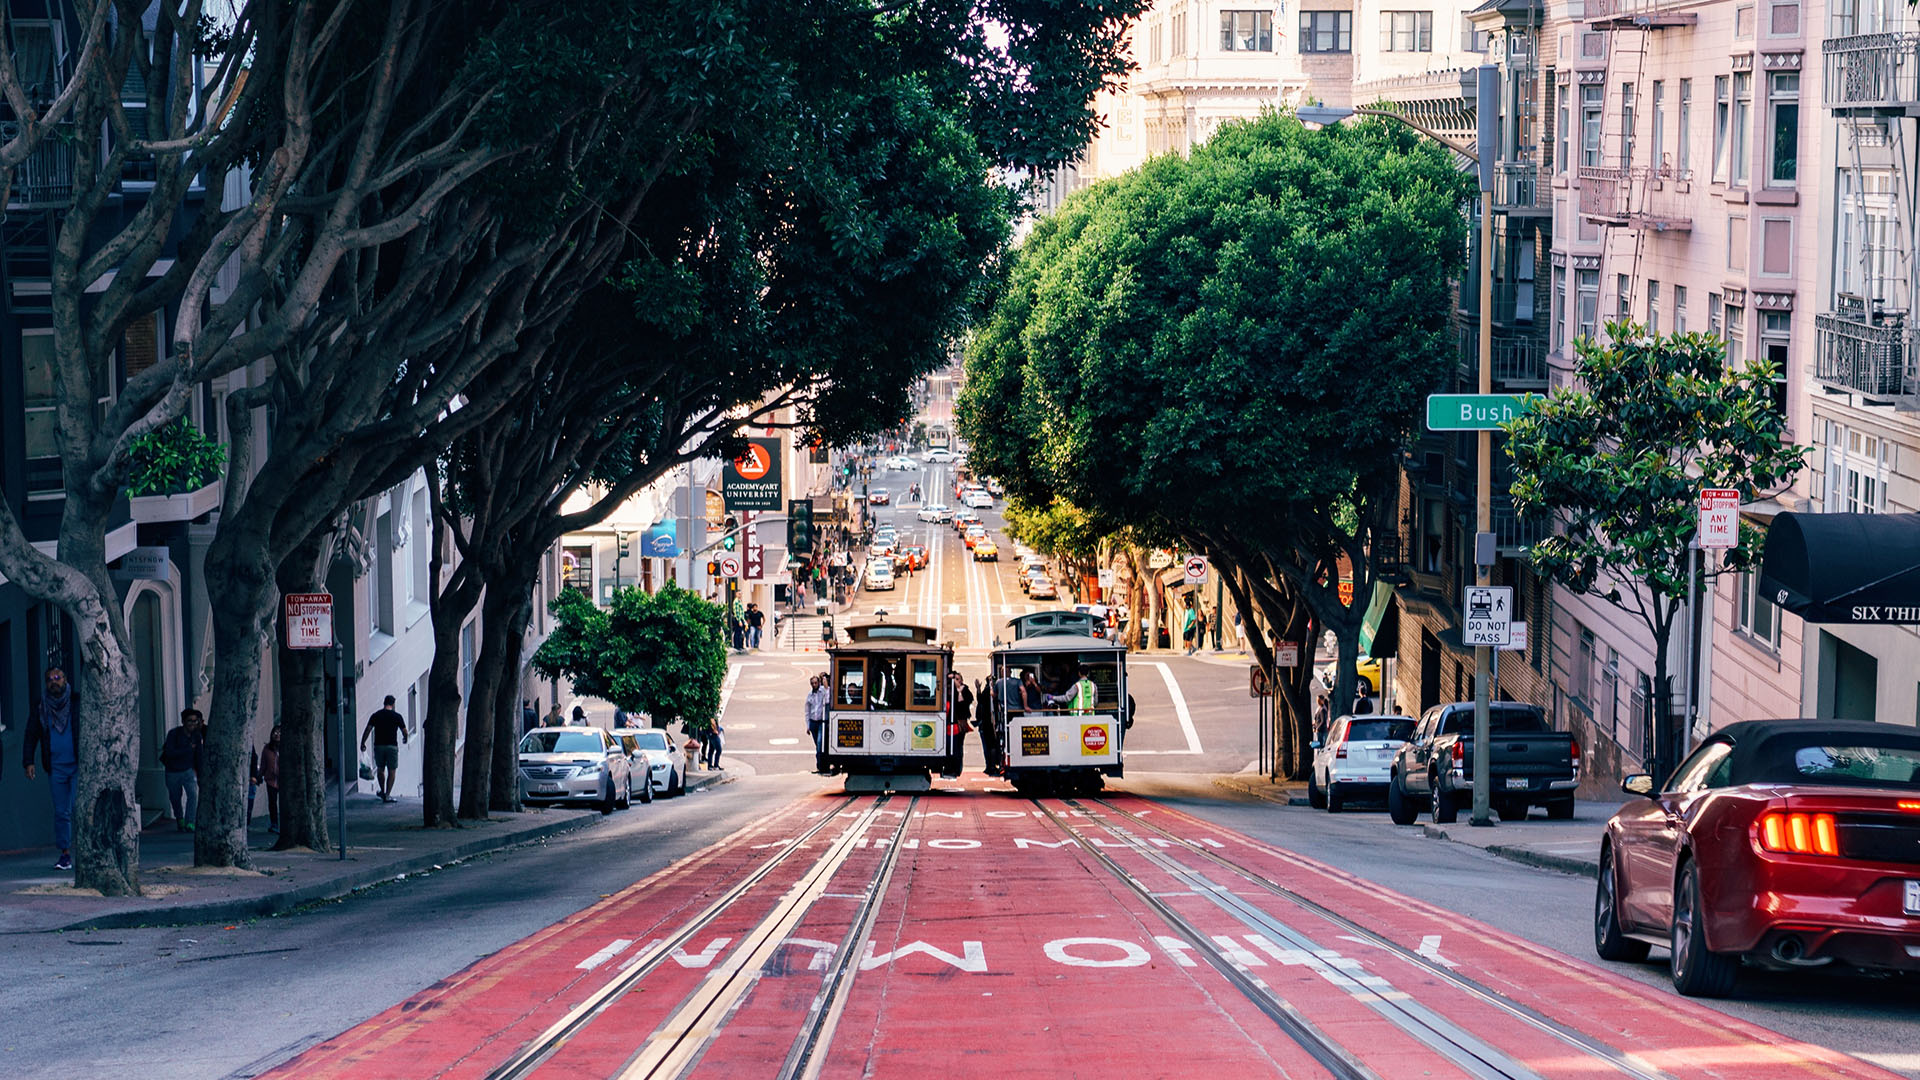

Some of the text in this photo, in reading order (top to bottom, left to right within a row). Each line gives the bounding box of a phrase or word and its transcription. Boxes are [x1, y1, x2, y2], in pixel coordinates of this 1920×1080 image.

[1460, 403, 1513, 421] Bush
[1701, 497, 1737, 509] NO STOPPING
[1710, 514, 1728, 523] ANY
[1709, 525, 1729, 534] TIME
[288, 603, 330, 615] NO STOPPING
[1851, 605, 1920, 620] SIX THI
[301, 617, 319, 626] ANY
[1468, 621, 1507, 631] DO NOT
[300, 627, 321, 637] TIME
[1474, 633, 1500, 642] PASS
[1909, 893, 1920, 909] 7
[1042, 934, 1461, 968] ONLY
